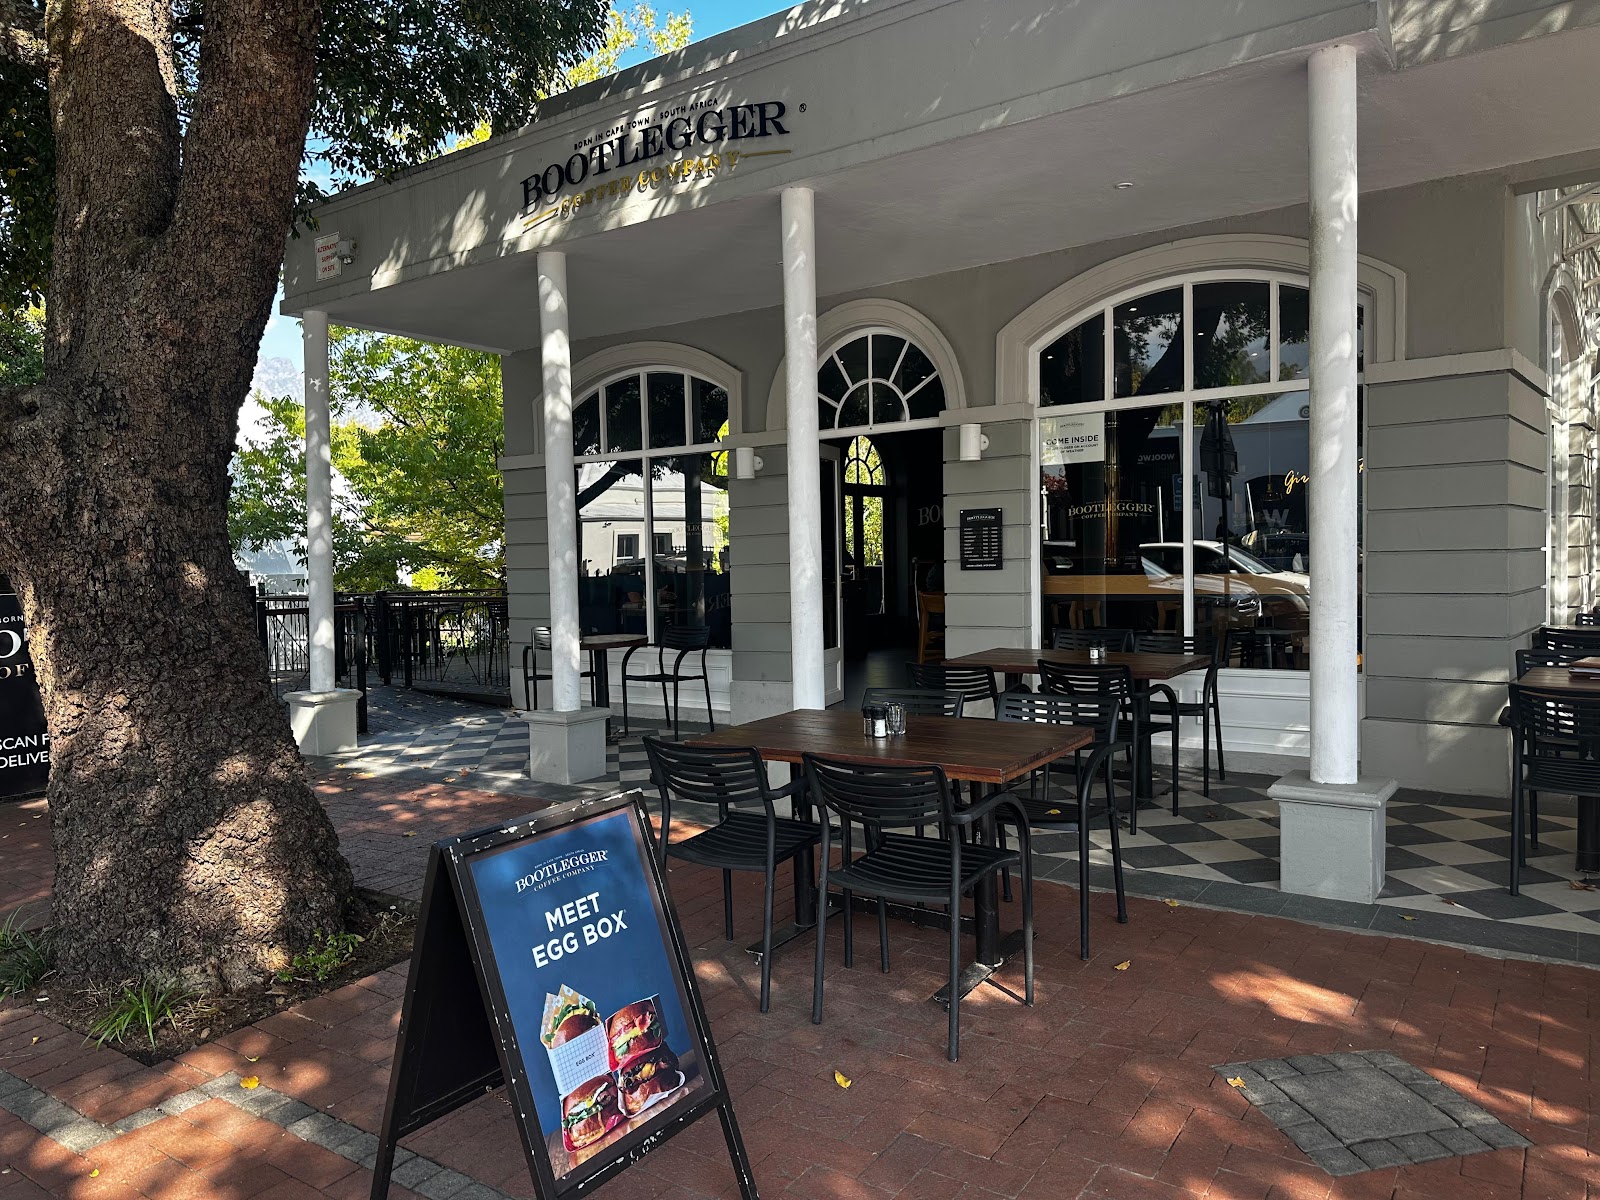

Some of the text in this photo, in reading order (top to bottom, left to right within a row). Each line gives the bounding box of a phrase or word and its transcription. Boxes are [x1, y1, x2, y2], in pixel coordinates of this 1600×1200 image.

[574, 97, 718, 150] BORN IN CAPE TOWN SOUTH AFRICA
[519, 101, 790, 209] BOOTLEGGER
[561, 150, 740, 212] COFFEE COMPANY
[1046, 434, 1099, 446] COME INSIDE
[917, 504, 944, 527] BO
[0, 614, 24, 624] ORN
[514, 850, 608, 894] BOOTLEGGER
[533, 864, 596, 892] COFFEE COMPANY
[544, 891, 600, 933] MEET
[531, 909, 628, 969] EGG BOX
